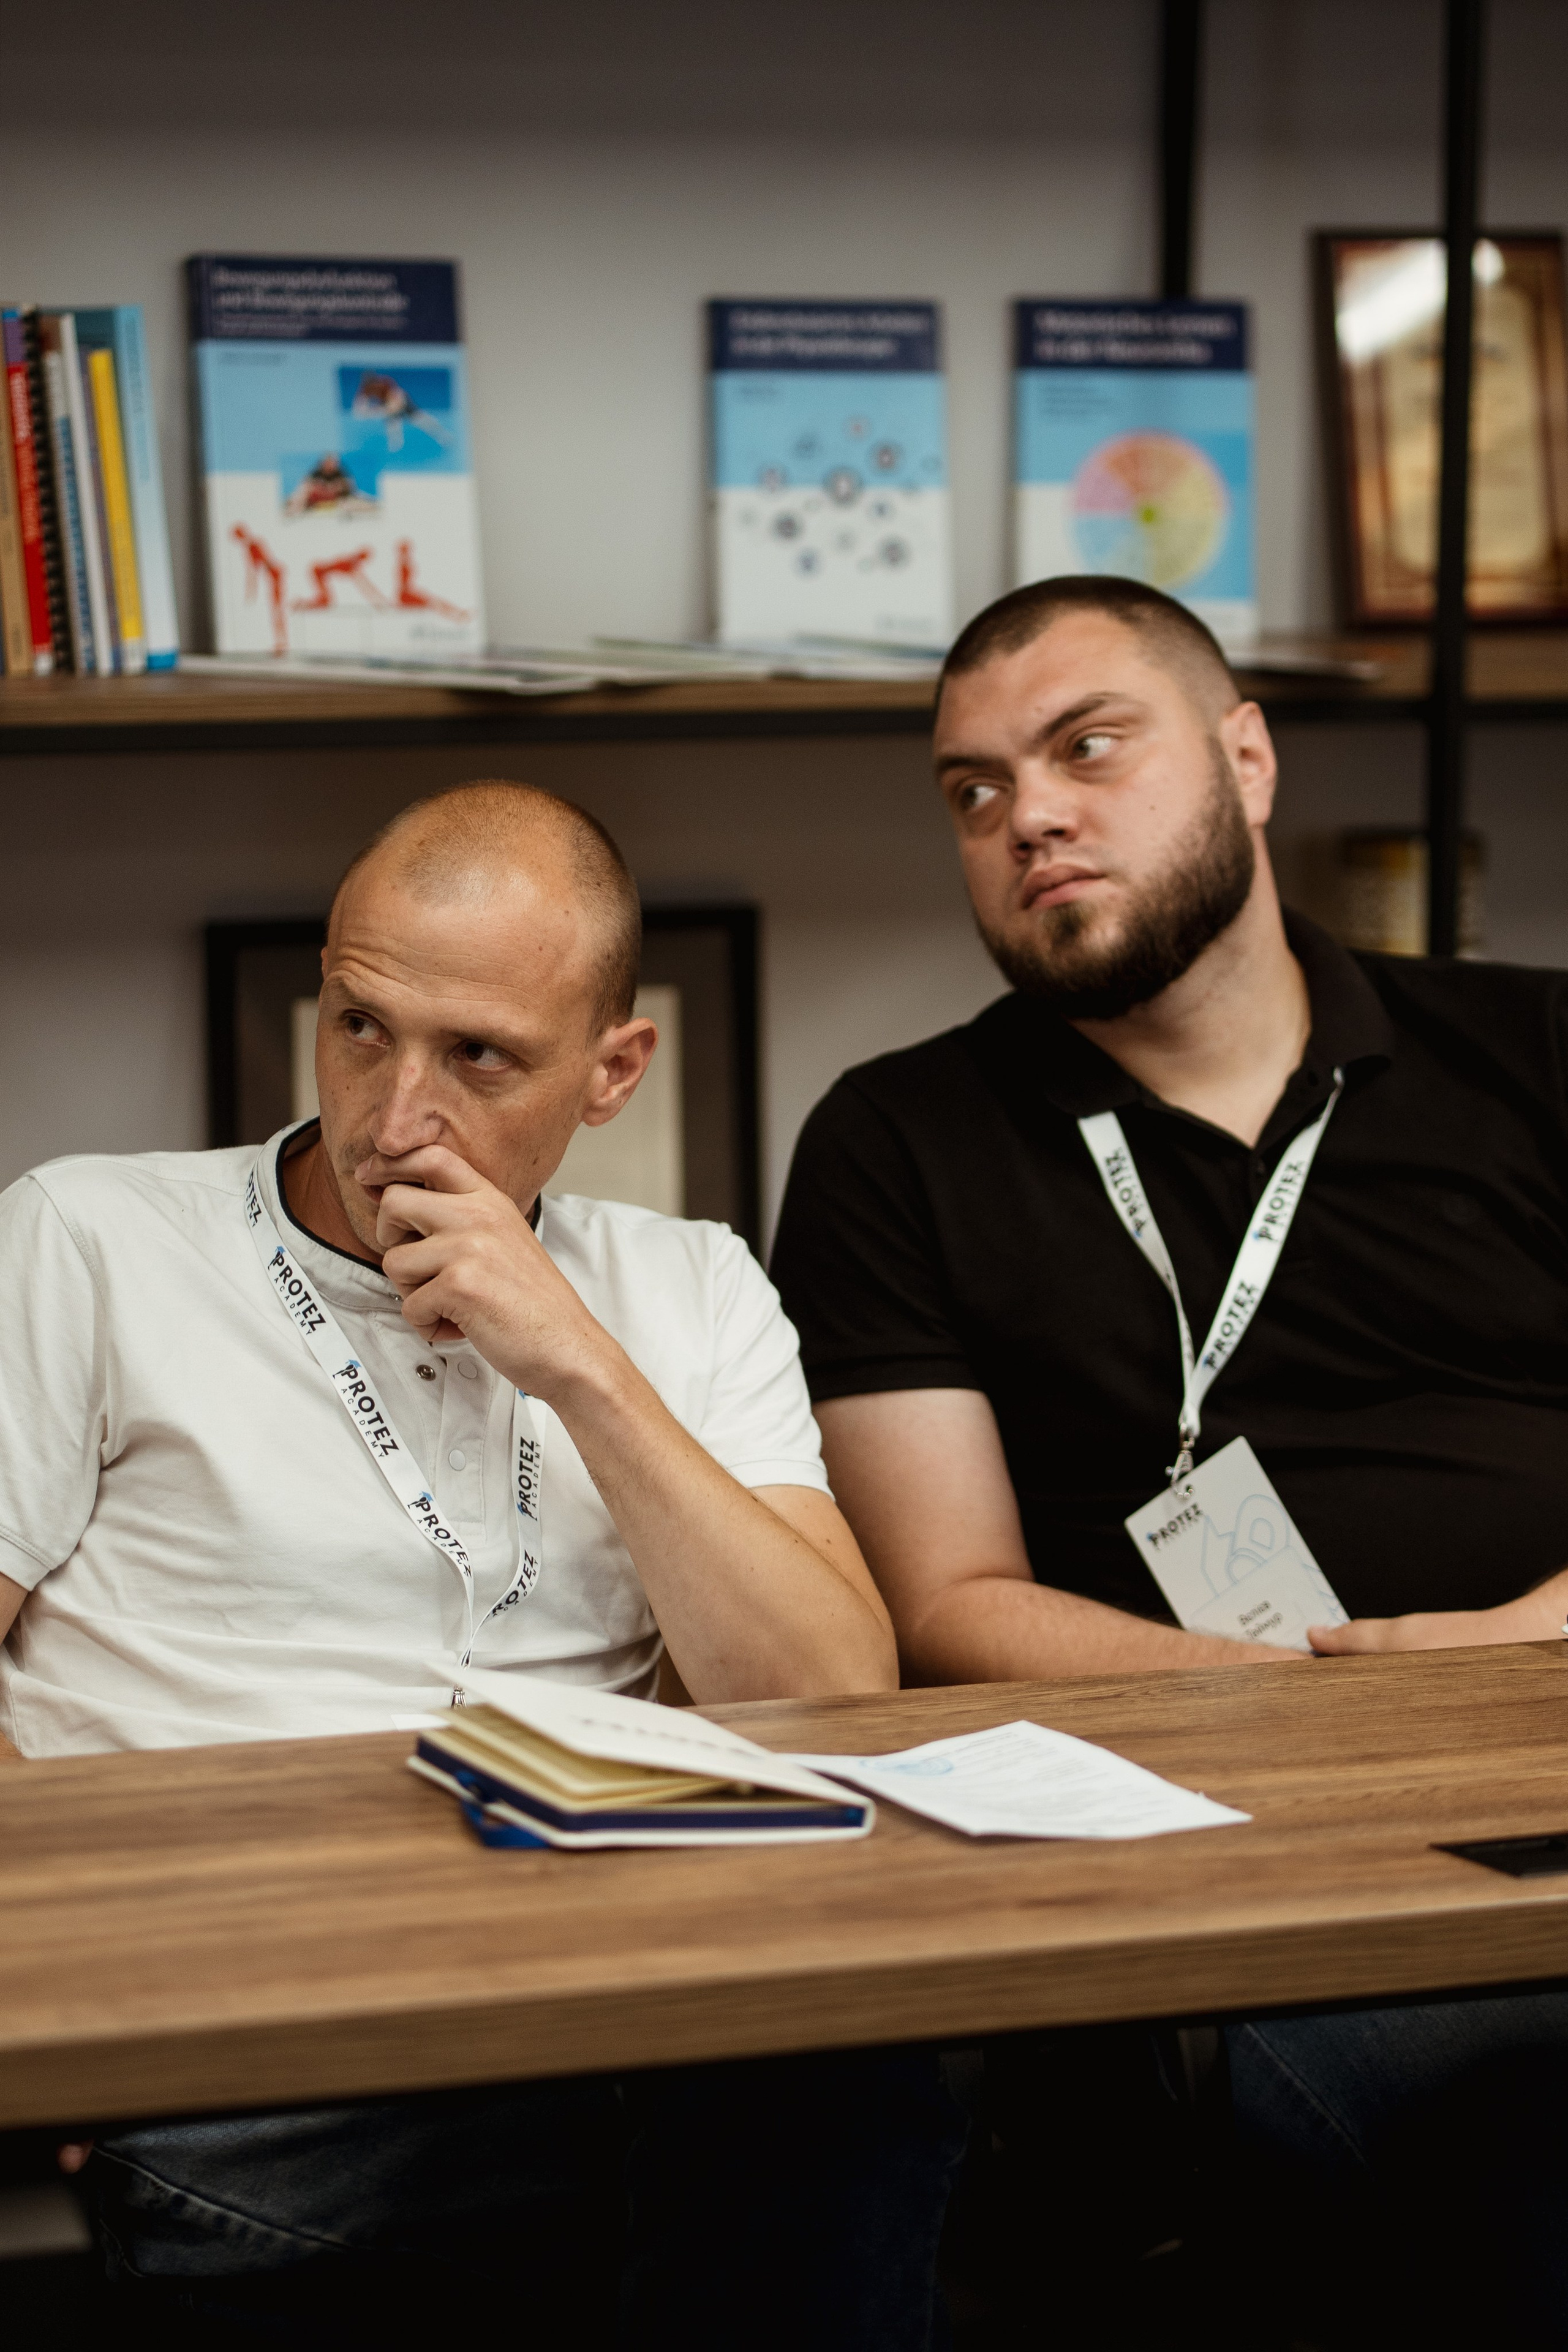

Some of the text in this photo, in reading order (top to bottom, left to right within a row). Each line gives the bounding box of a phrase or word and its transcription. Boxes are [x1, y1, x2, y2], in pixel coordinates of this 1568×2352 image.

[1258, 1161, 1299, 1239] PROTEZ
[268, 1251, 326, 1332] PROTEZ
[274, 1278, 312, 1335] ACADEMY
[1206, 1280, 1251, 1368] PROTEZ
[333, 1363, 399, 1456] PROTEZ
[341, 1389, 385, 1458] ACADEMY
[518, 1436, 537, 1521] PROTEZ
[532, 1442, 541, 1509] ACADEMY
[407, 1497, 472, 1578] PROTEZ
[417, 1519, 469, 1577] ACADEMY
[1149, 1502, 1200, 1547] PROTEZ
[485, 1549, 533, 1619] ROTEZ
